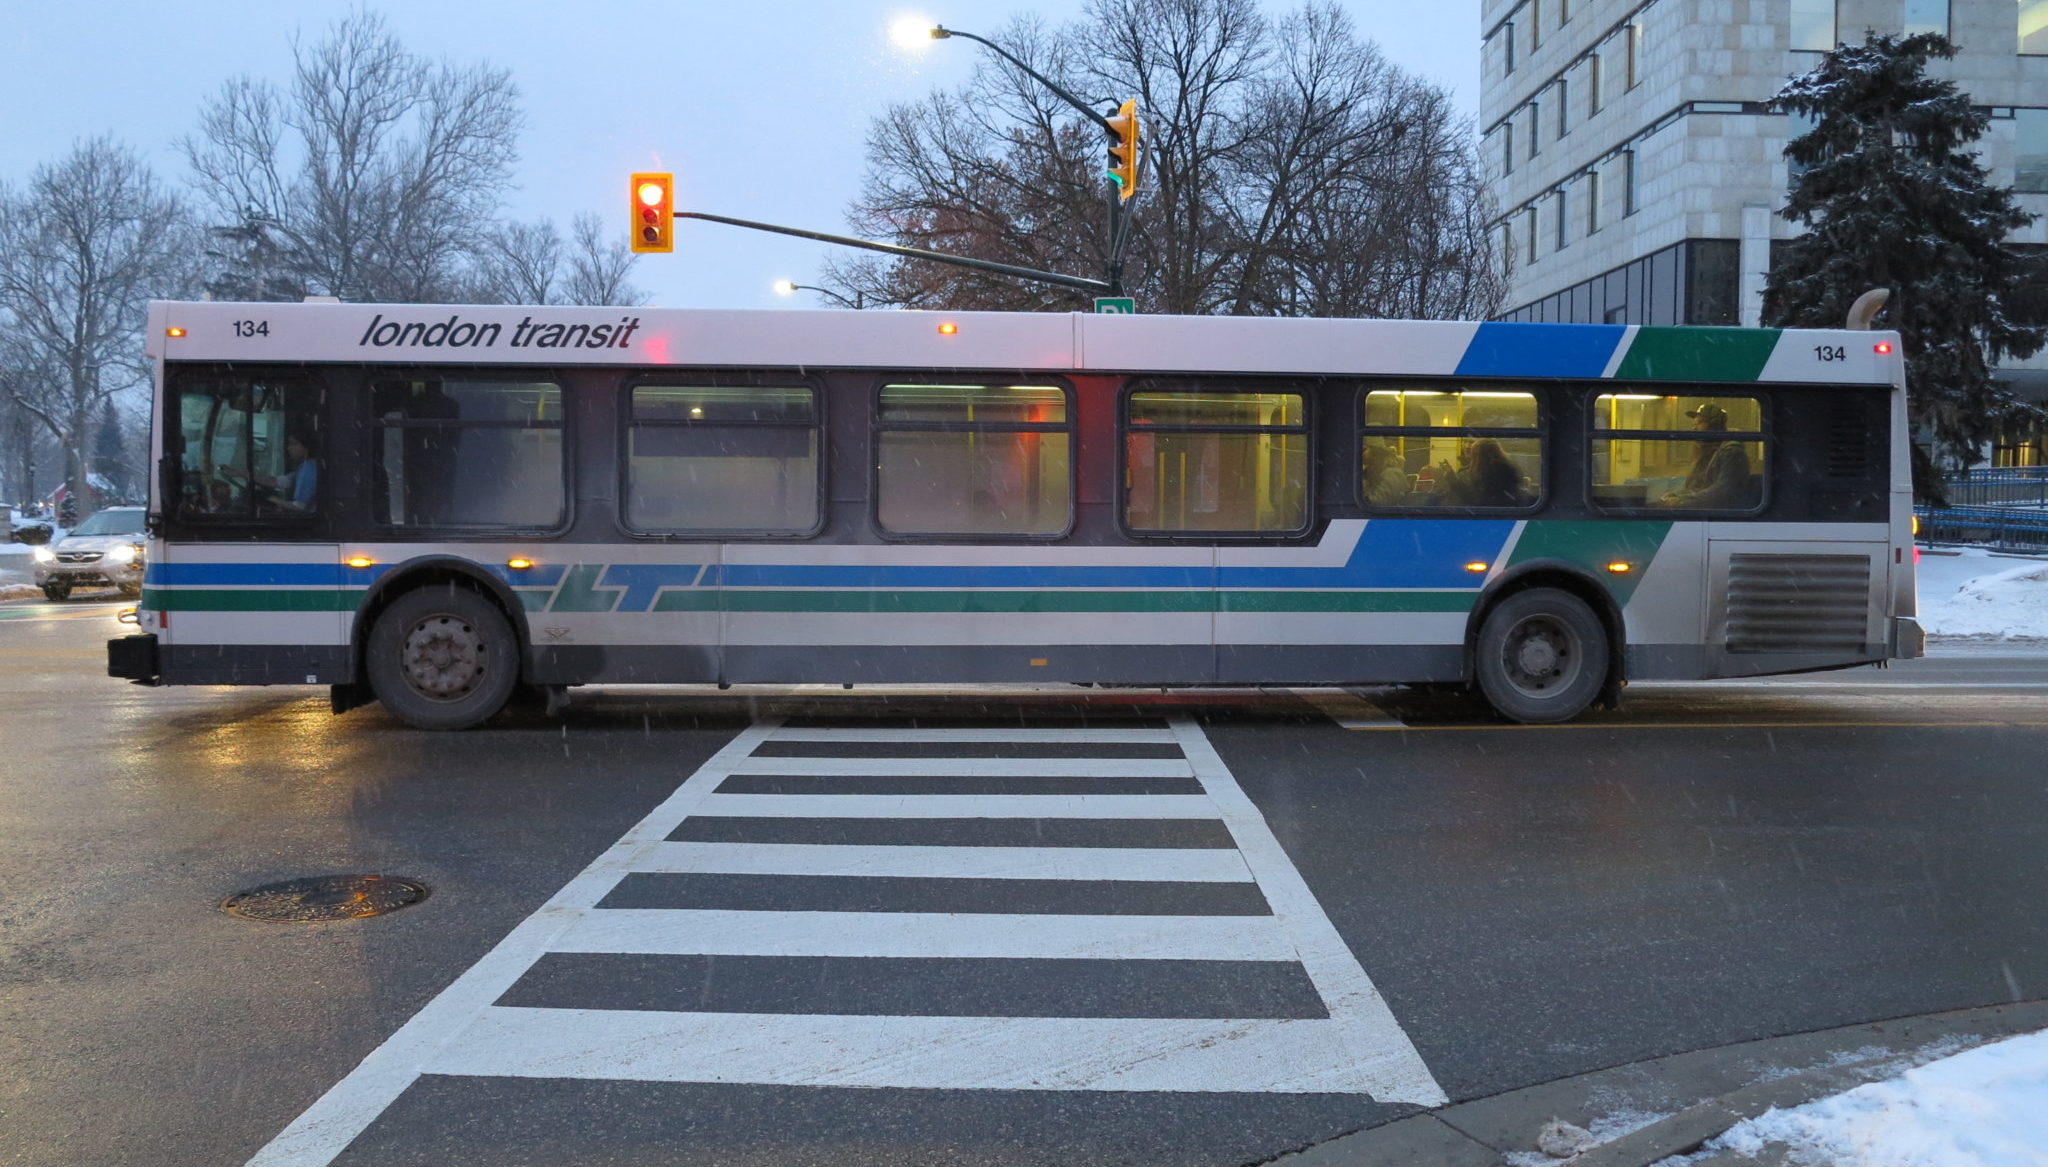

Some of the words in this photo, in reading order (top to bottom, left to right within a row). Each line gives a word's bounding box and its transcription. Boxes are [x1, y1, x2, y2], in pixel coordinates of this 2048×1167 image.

[233, 320, 270, 337] 134
[359, 314, 502, 348] london
[510, 316, 640, 349] transit
[1814, 346, 1846, 362] 134
